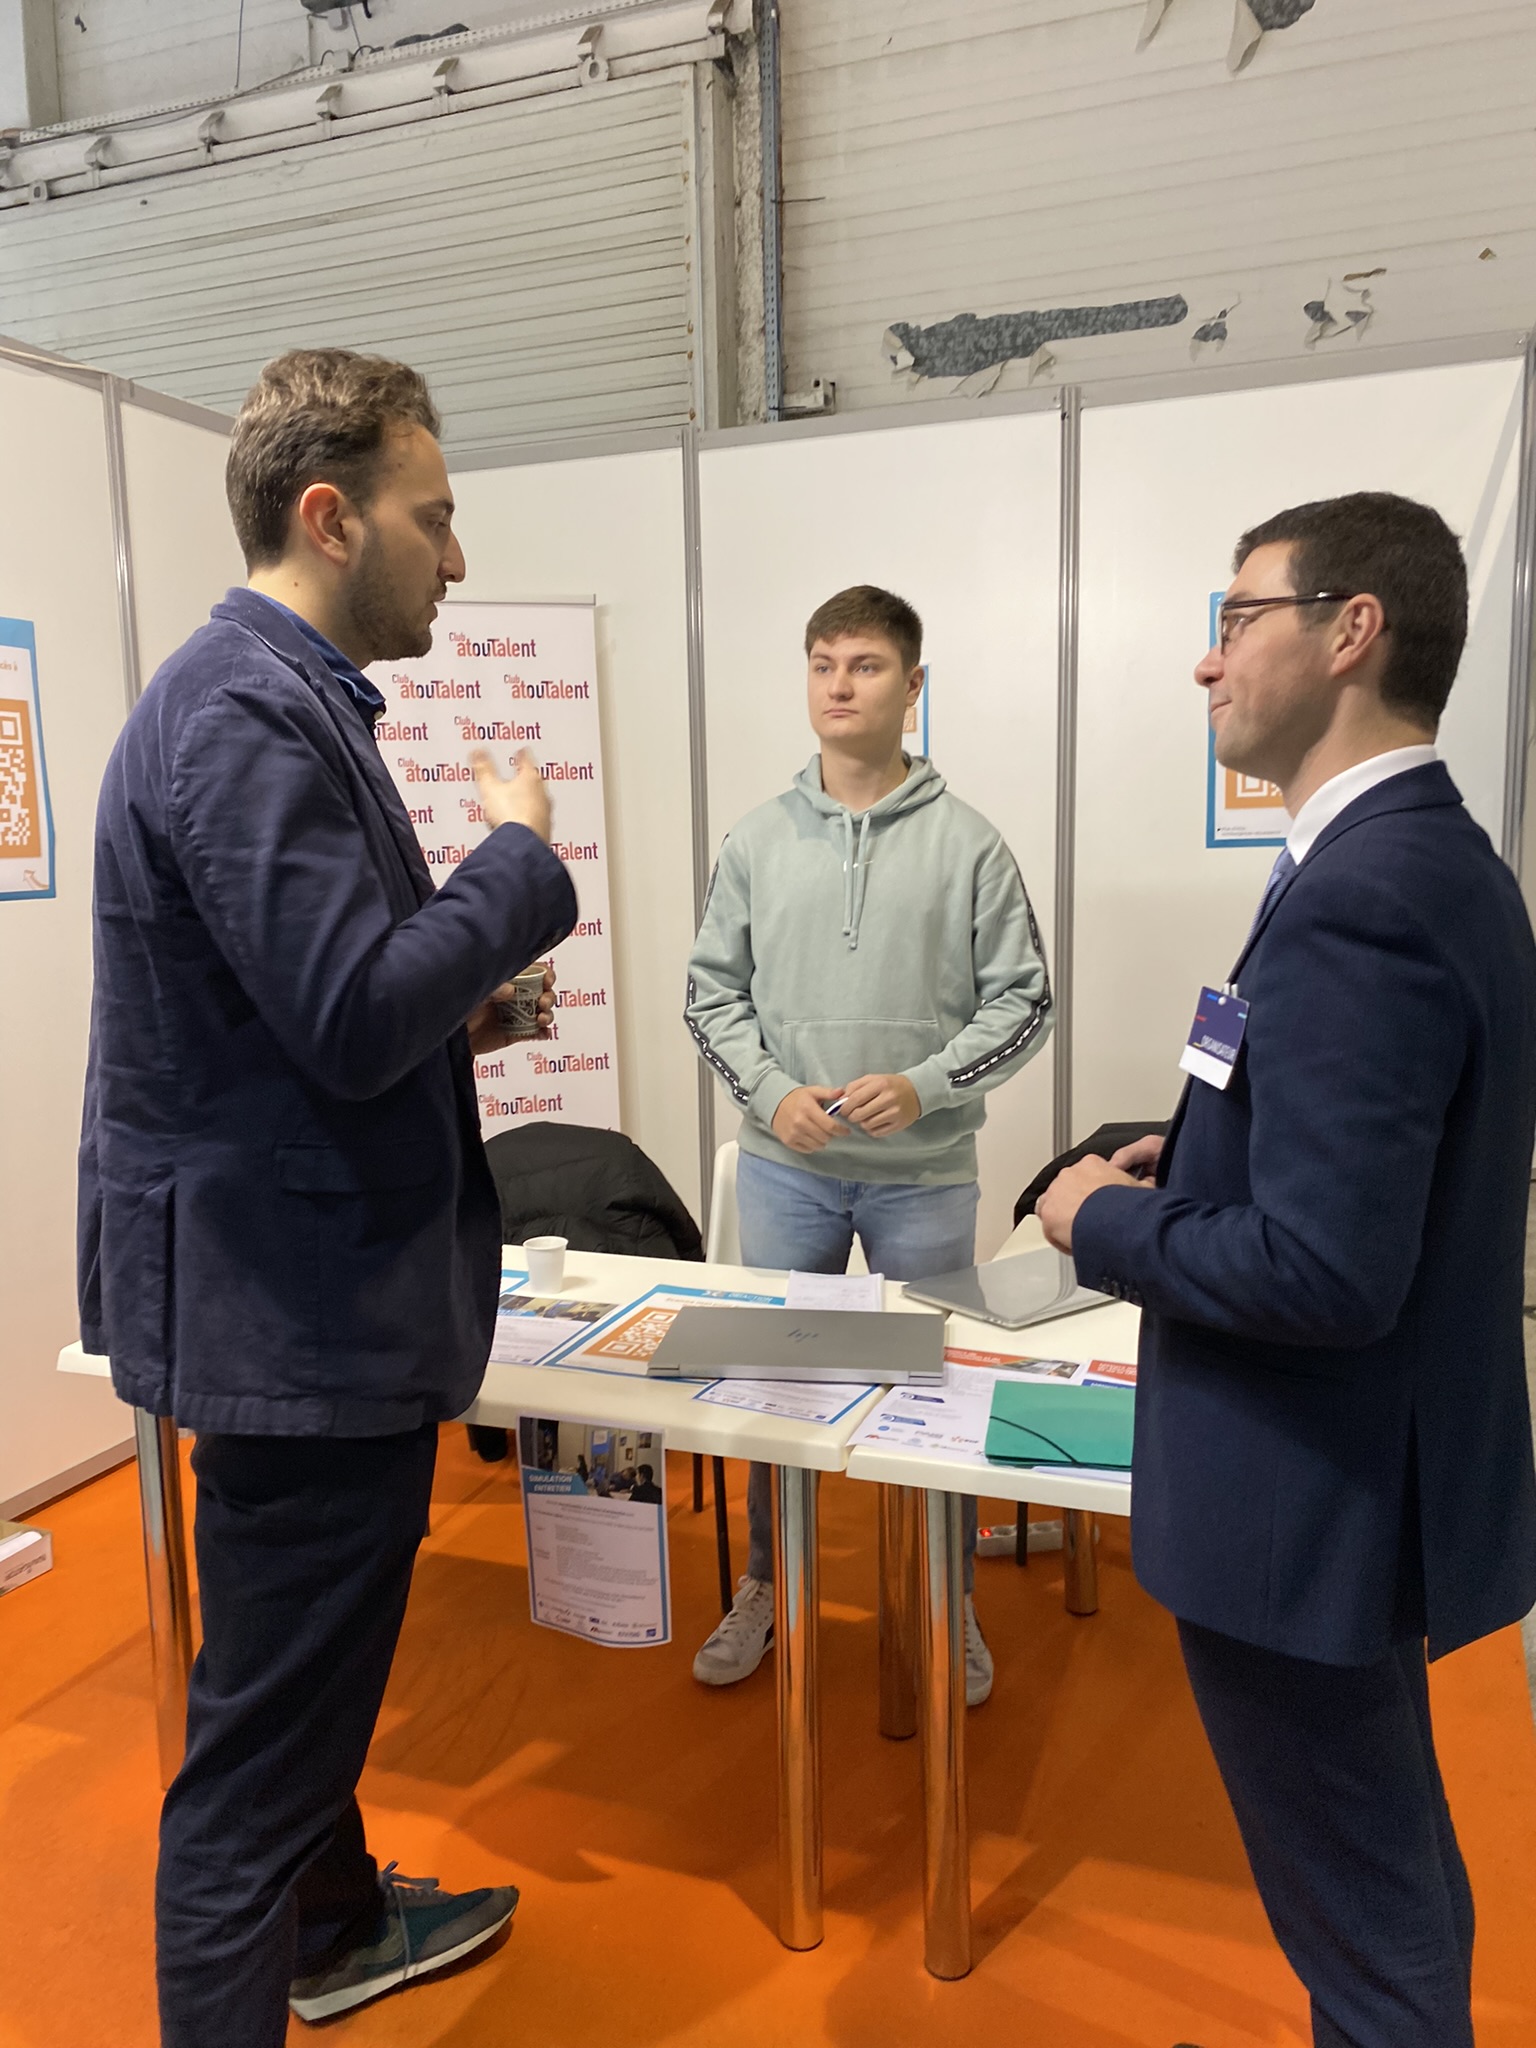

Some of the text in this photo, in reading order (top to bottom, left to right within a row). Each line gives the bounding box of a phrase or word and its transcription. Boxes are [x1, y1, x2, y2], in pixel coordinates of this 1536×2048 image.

[449, 632, 465, 641] Club
[457, 637, 536, 657] atouTalent
[392, 674, 409, 683] Club
[504, 674, 520, 684] Club
[400, 679, 481, 699] atouTalent
[511, 679, 589, 699] atouTalent
[454, 716, 471, 725] Club
[462, 720, 541, 740] atouTalent
[397, 758, 414, 767] Club
[406, 762, 476, 782] atouTale
[460, 799, 476, 807] Club
[551, 841, 598, 861] Talent
[527, 1052, 543, 1061] Club
[534, 1053, 610, 1075] atouTalent
[479, 1094, 495, 1103] Club
[486, 1093, 563, 1117] atouTalent
[528, 1474, 573, 1483] SIMULATION
